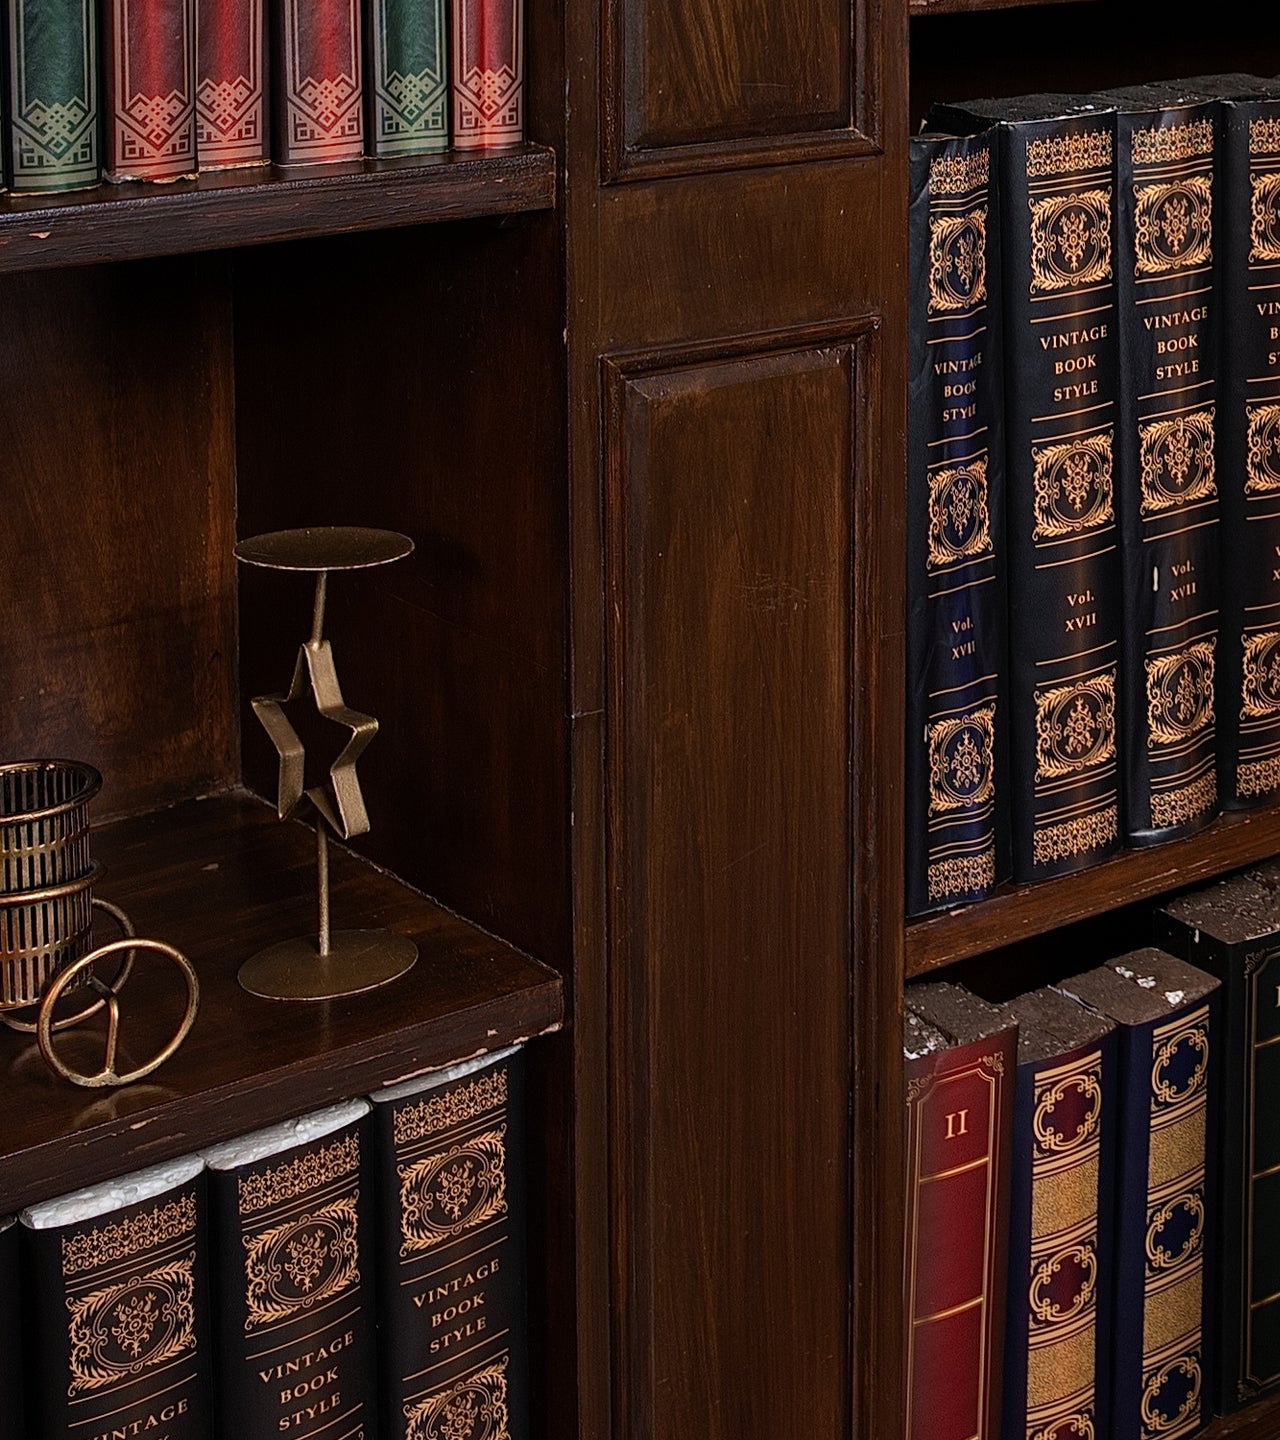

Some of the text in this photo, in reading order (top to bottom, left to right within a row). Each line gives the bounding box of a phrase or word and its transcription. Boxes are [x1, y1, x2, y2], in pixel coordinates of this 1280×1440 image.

[1143, 306, 1208, 330] VINTAGE
[1040, 324, 1107, 350] VINTAGE
[1157, 334, 1198, 354] BOOK
[934, 352, 983, 376] VINTAGE
[1055, 354, 1096, 375] BOOK
[1156, 359, 1199, 380] STYLE
[944, 379, 977, 398] BOOK
[1054, 380, 1098, 402] STYLE
[942, 403, 977, 422] STYLE
[1171, 560, 1195, 577] Vol.
[1067, 590, 1095, 607] Vol.
[1170, 582, 1196, 602] XVII
[952, 616, 974, 633] Vol.
[1065, 612, 1096, 632] XVII
[952, 640, 975, 660] XVII
[944, 1109, 968, 1139] II
[413, 1258, 499, 1308] VINTAGE
[431, 1292, 485, 1328] BOOK
[430, 1316, 486, 1354] STYLE
[259, 1330, 353, 1383] VINTAGE
[280, 1366, 338, 1404] BOOK
[279, 1392, 341, 1431] STYLE
